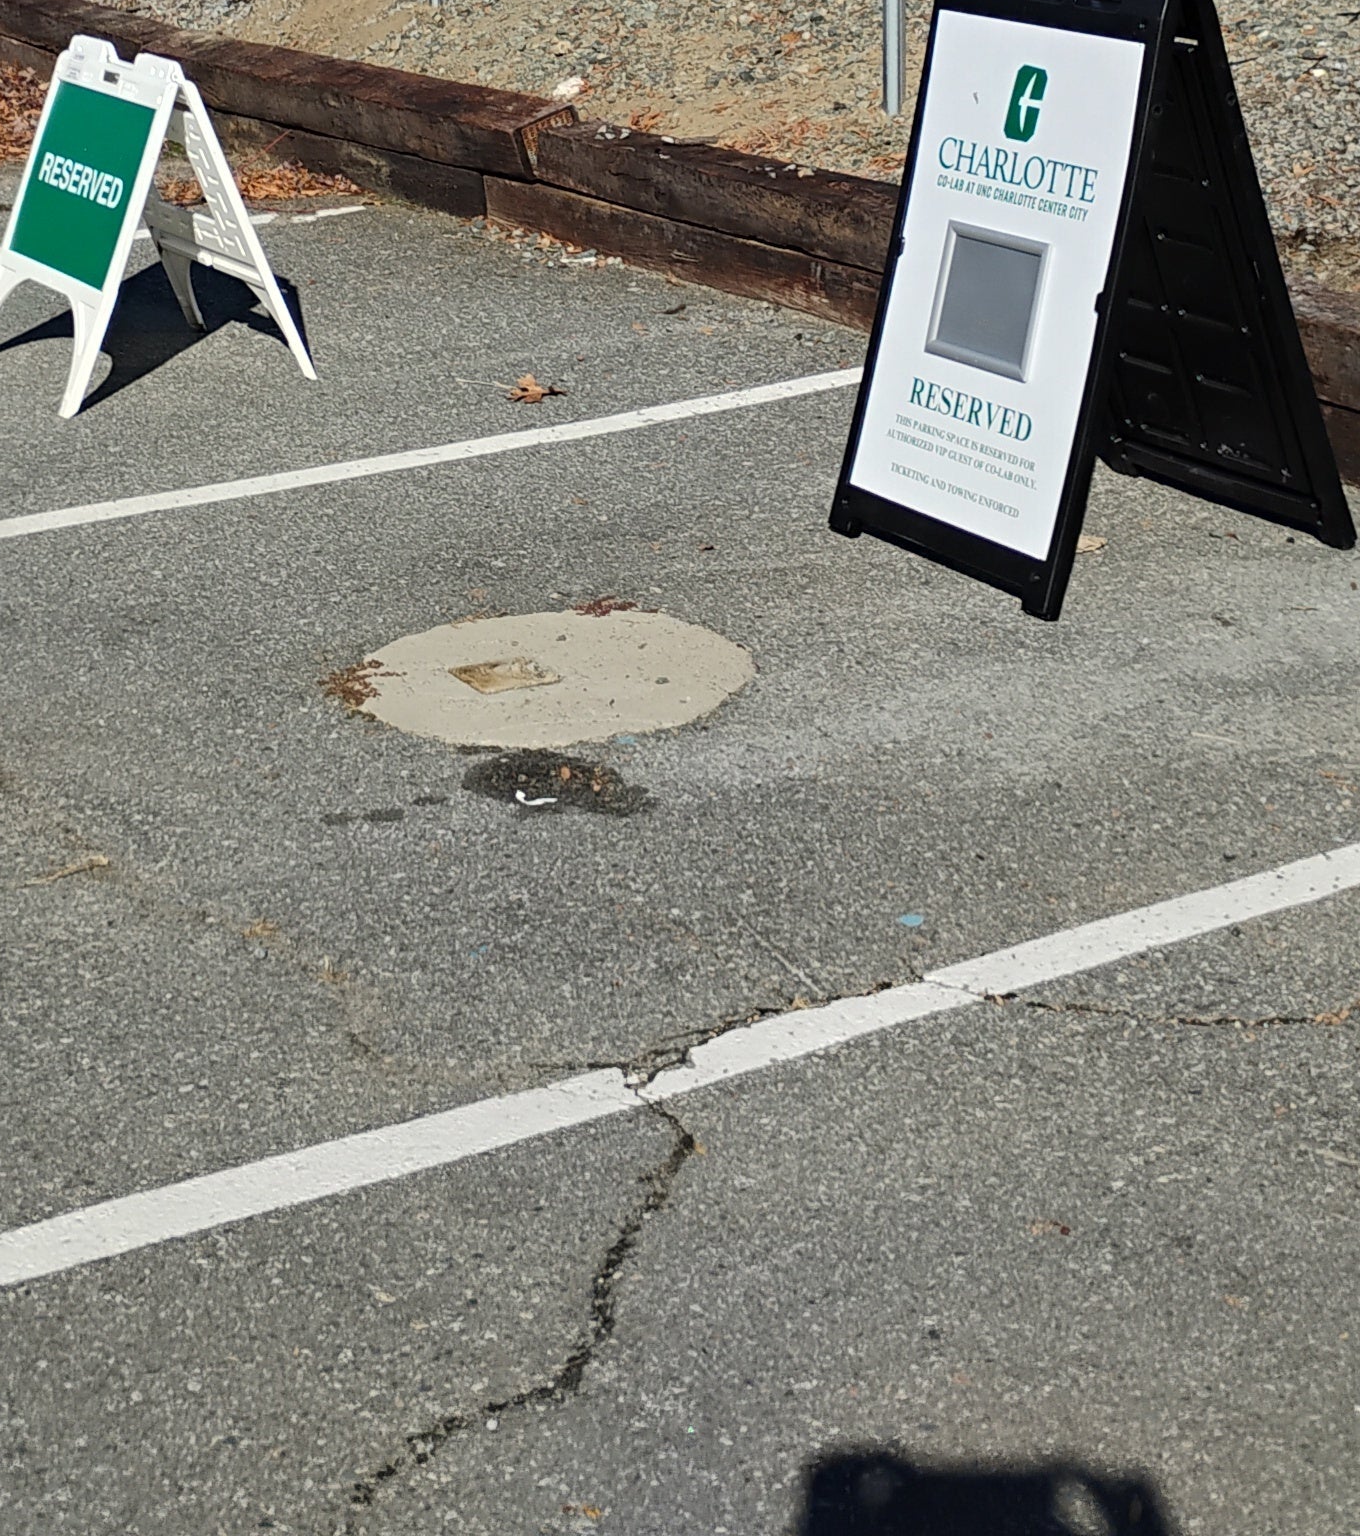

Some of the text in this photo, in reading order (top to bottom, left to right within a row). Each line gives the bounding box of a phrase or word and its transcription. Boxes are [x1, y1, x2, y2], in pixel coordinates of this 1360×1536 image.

[38, 152, 124, 208] RESERVED
[937, 174, 1088, 221] CO-LAB AT UNC CHARLOTTE CENTER CITY
[939, 137, 1098, 203] CHARLOTTE
[909, 377, 1032, 441] RESERVED
[887, 429, 934, 452] AUTHORIZED
[935, 445, 948, 456] VIP
[948, 450, 973, 466] GUEST
[973, 460, 984, 469] OF
[985, 463, 1013, 481] CO-LAB
[896, 414, 1035, 471] THIS PARKING SPACE IS RESERVED FOR
[891, 462, 1019, 518] TICKETING AND TOWING ENFORCED
